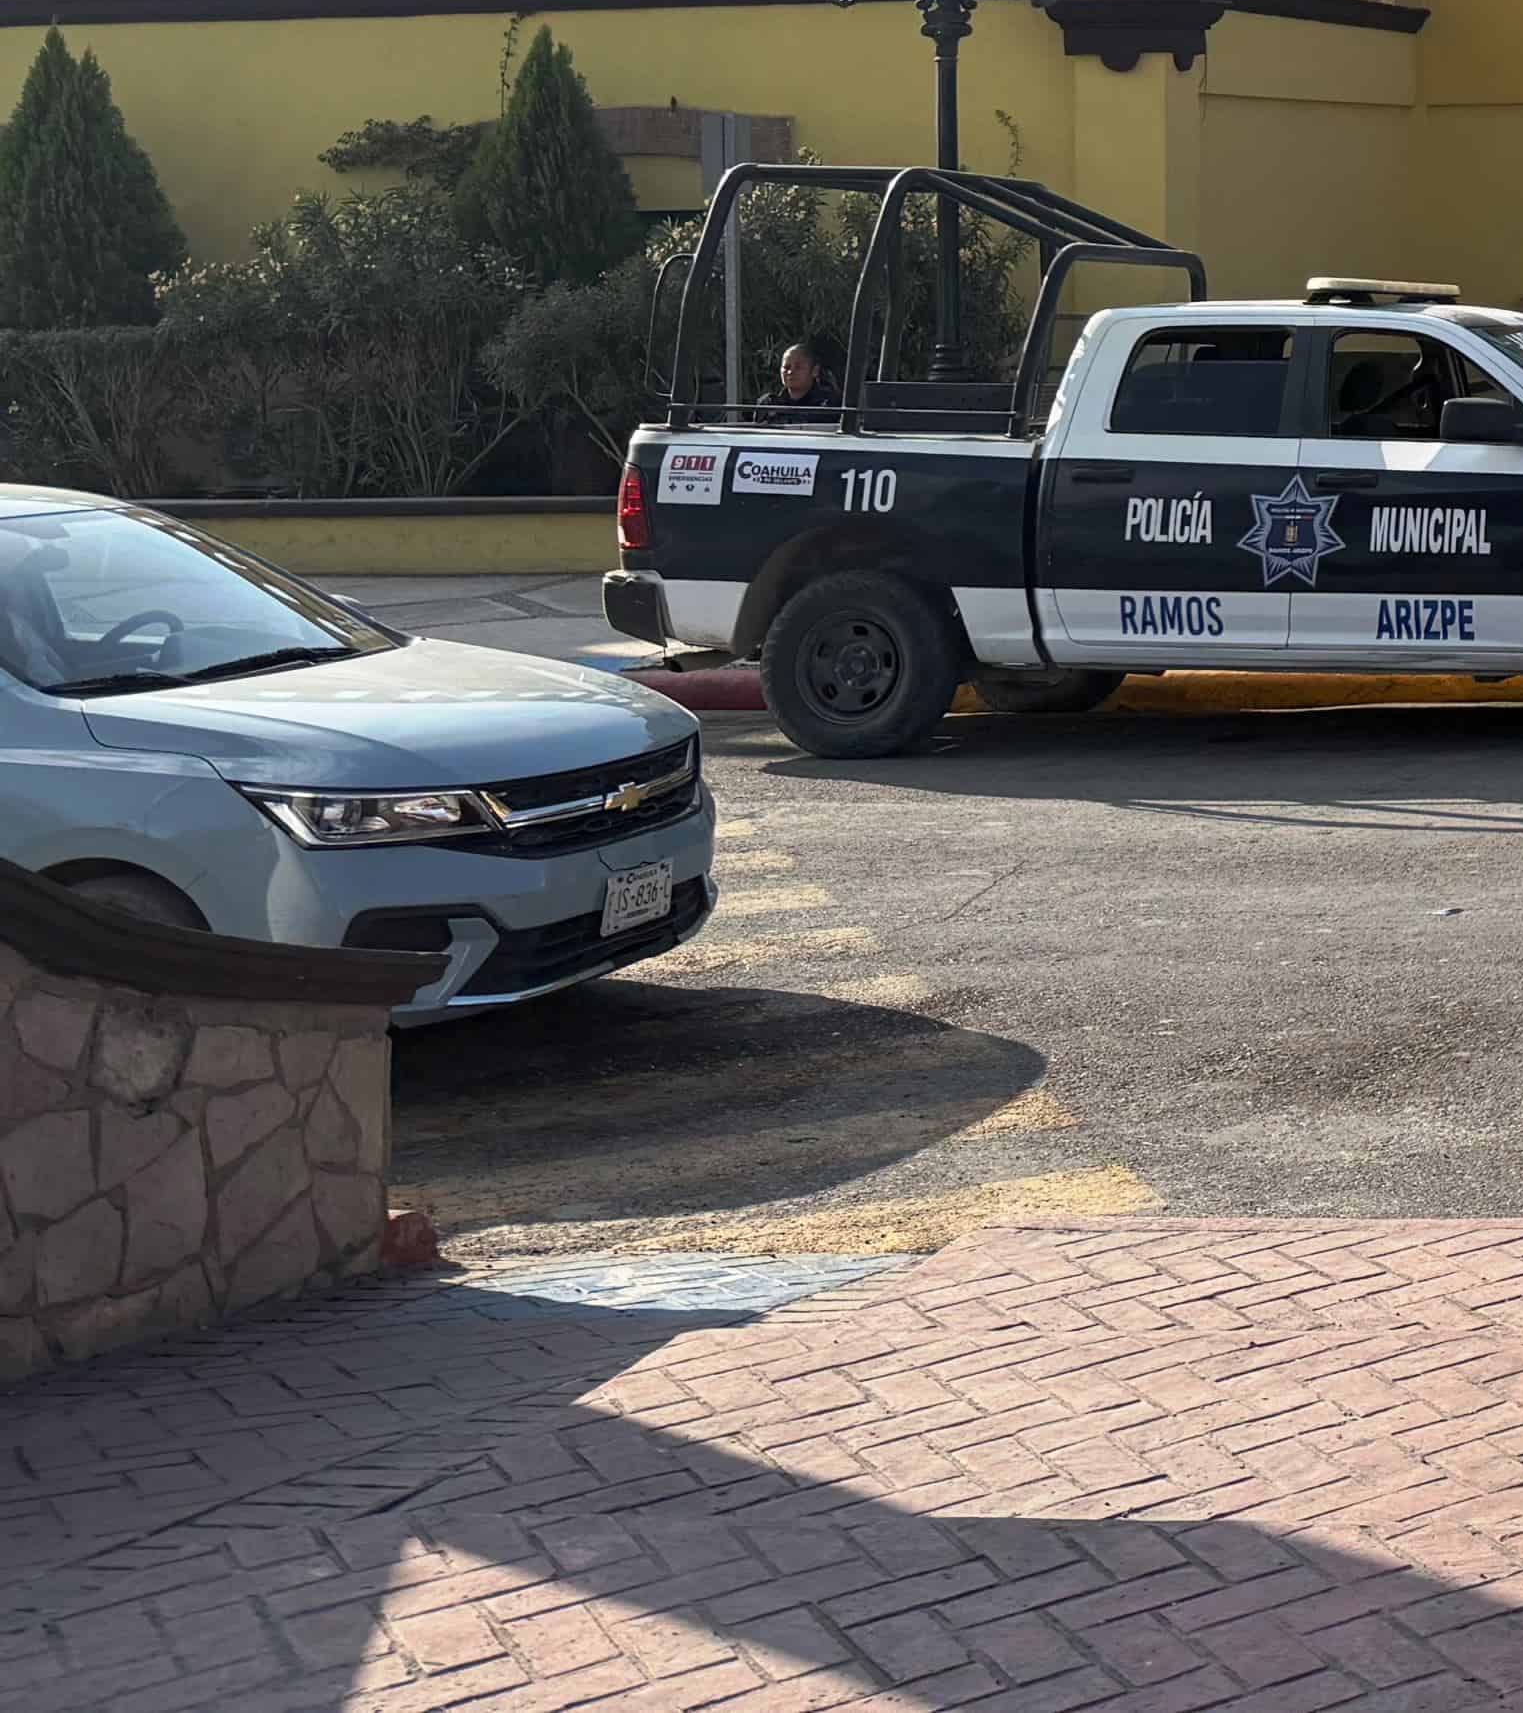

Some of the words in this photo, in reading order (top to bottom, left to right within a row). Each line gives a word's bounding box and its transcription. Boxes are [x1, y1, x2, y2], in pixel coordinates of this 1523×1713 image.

[672, 456, 715, 470] 911
[737, 461, 812, 479] COAHUILA
[841, 468, 897, 512] 110
[1124, 492, 1212, 544] POLICÍA
[1369, 506, 1491, 554] MUNICIPAL
[1120, 595, 1224, 636] RAMOS
[1376, 599, 1475, 641] ARIZPE
